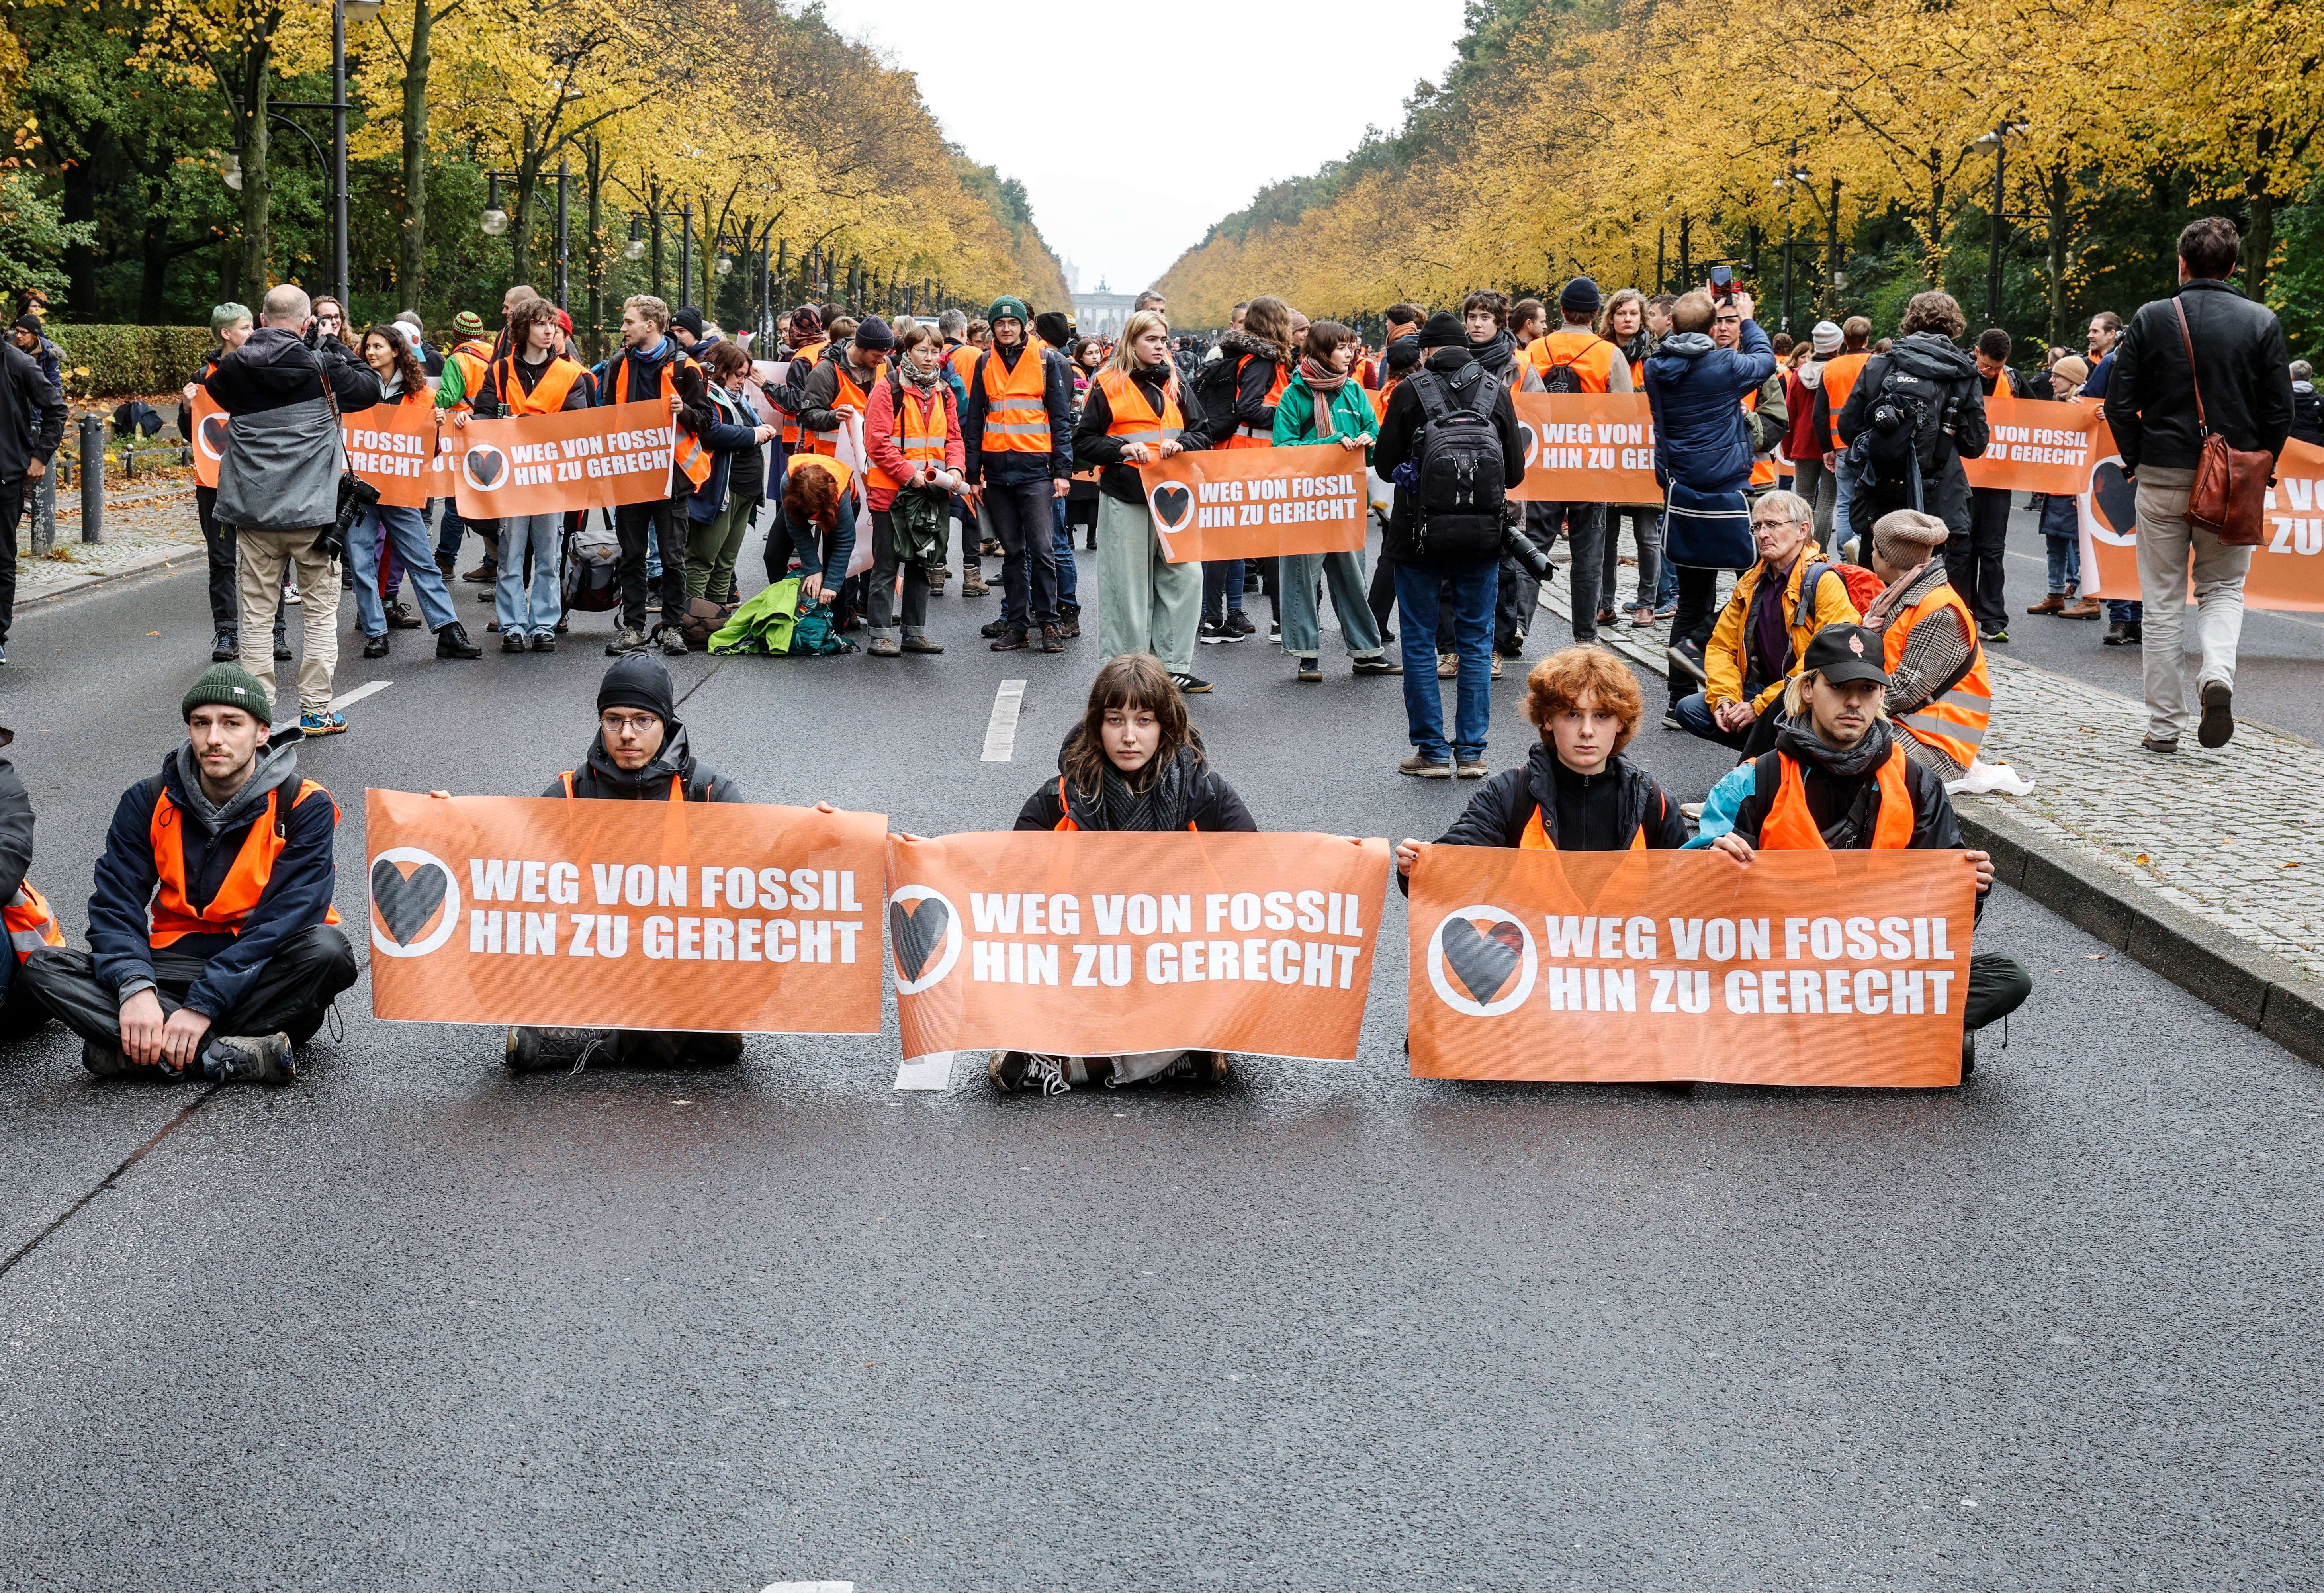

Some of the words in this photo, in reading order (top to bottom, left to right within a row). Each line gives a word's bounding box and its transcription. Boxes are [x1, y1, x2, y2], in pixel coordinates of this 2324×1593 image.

[353, 429, 425, 455] FOSSIL
[1542, 423, 1592, 444] WEG
[1597, 423, 1642, 444] VON
[1994, 425, 2029, 443] VON
[2033, 428, 2088, 448] FOSSIL
[510, 442, 559, 464] WEG
[560, 436, 603, 458] VON
[1543, 447, 1582, 468] HIN
[1587, 448, 1615, 469] ZU
[1985, 443, 2007, 460] ZU
[2011, 445, 2087, 466] GERECHT
[513, 464, 553, 486] HIN
[556, 461, 583, 482] ZU
[1198, 481, 1243, 503] WEG
[1247, 479, 1287, 501] VON
[1292, 474, 1357, 498] FOSSIL
[1198, 506, 1235, 528] HIN
[1239, 504, 1264, 526] ZU
[1268, 498, 1358, 524] GERECHT
[2268, 517, 2322, 555] ZU
[469, 858, 579, 905] WEG
[592, 863, 688, 907] VON
[701, 866, 863, 912] FOSSIL
[970, 892, 1080, 935] WEG
[1091, 894, 1191, 936] VON
[1205, 890, 1363, 937] FOSSIL
[469, 909, 557, 956] HIN
[569, 913, 628, 959] ZU
[642, 916, 863, 964] GERECHT
[1545, 915, 1657, 960] WEG
[1669, 917, 1771, 961] VON
[1785, 916, 1954, 961] FOSSIL
[972, 941, 1059, 986] HIN
[1072, 944, 1132, 987] ZU
[1146, 939, 1361, 990] GERECHT
[1548, 967, 1636, 1012] HIN
[1649, 969, 1710, 1014] ZU
[1725, 969, 1955, 1015] GERECHT
